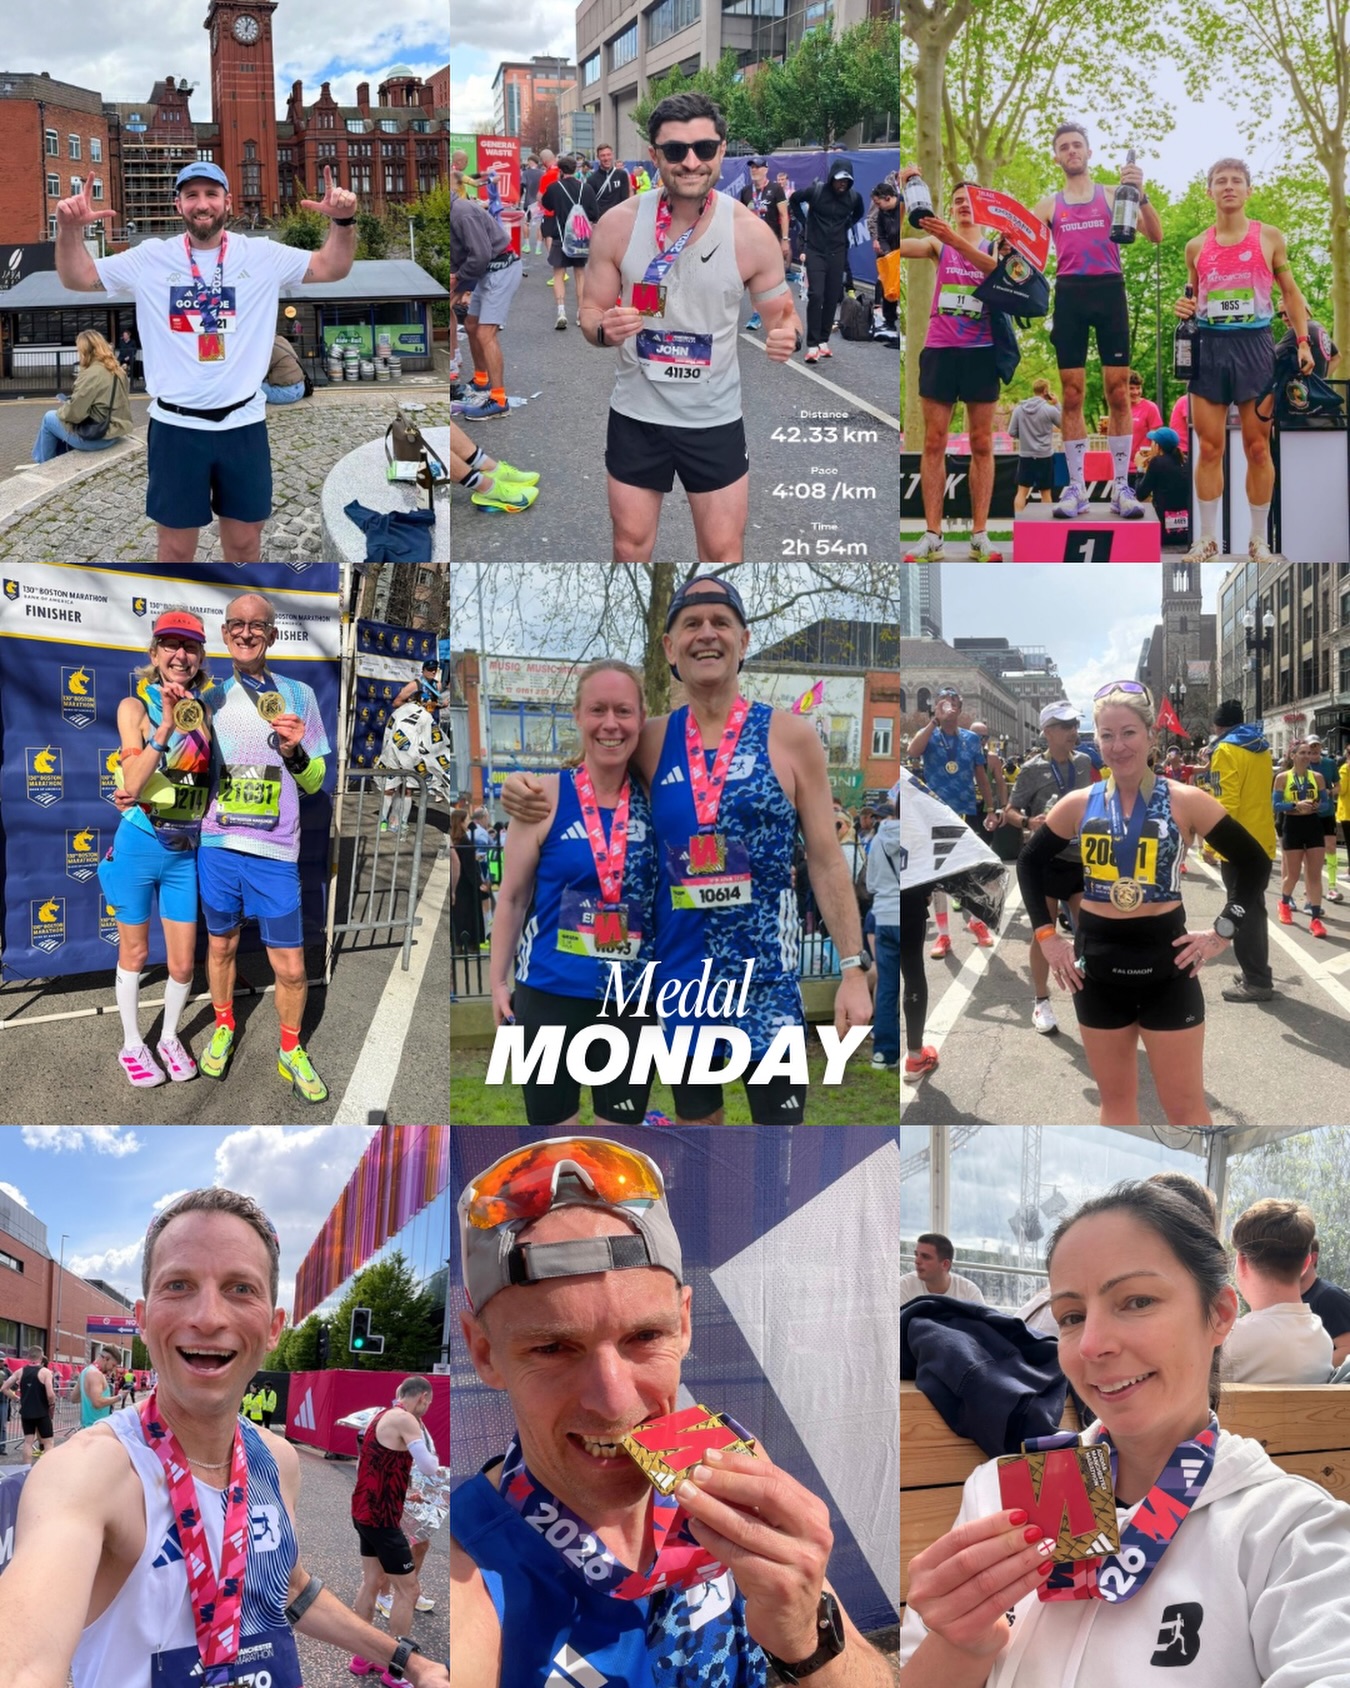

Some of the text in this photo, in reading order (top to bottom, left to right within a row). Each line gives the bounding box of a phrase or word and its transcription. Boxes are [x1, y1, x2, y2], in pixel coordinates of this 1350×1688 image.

[480, 140, 518, 150] GENERAL
[485, 148, 513, 158] WASTE
[1060, 219, 1105, 232] TOULOUSE
[175, 299, 192, 308] GO
[957, 295, 966, 305] 11
[1220, 300, 1240, 311] 1855
[656, 345, 689, 356] JOHN
[664, 366, 701, 379] 41130
[1077, 538, 1096, 562] 1
[39, 588, 68, 599] BOSTON
[69, 591, 108, 603] MARATHON
[26, 605, 82, 624] FINISHER
[189, 605, 224, 616] MARATHON
[298, 614, 331, 622] MARATHON
[276, 630, 309, 641] ISHER
[489, 660, 521, 672] MUSIC
[526, 663, 557, 674] MUSIC
[699, 886, 741, 904] 10614
[1112, 967, 1154, 976] SALOMON
[525, 1502, 609, 1582] 2026
[238, 1642, 273, 1654] ANCHESTER
[235, 1649, 274, 1665] MARATHON
